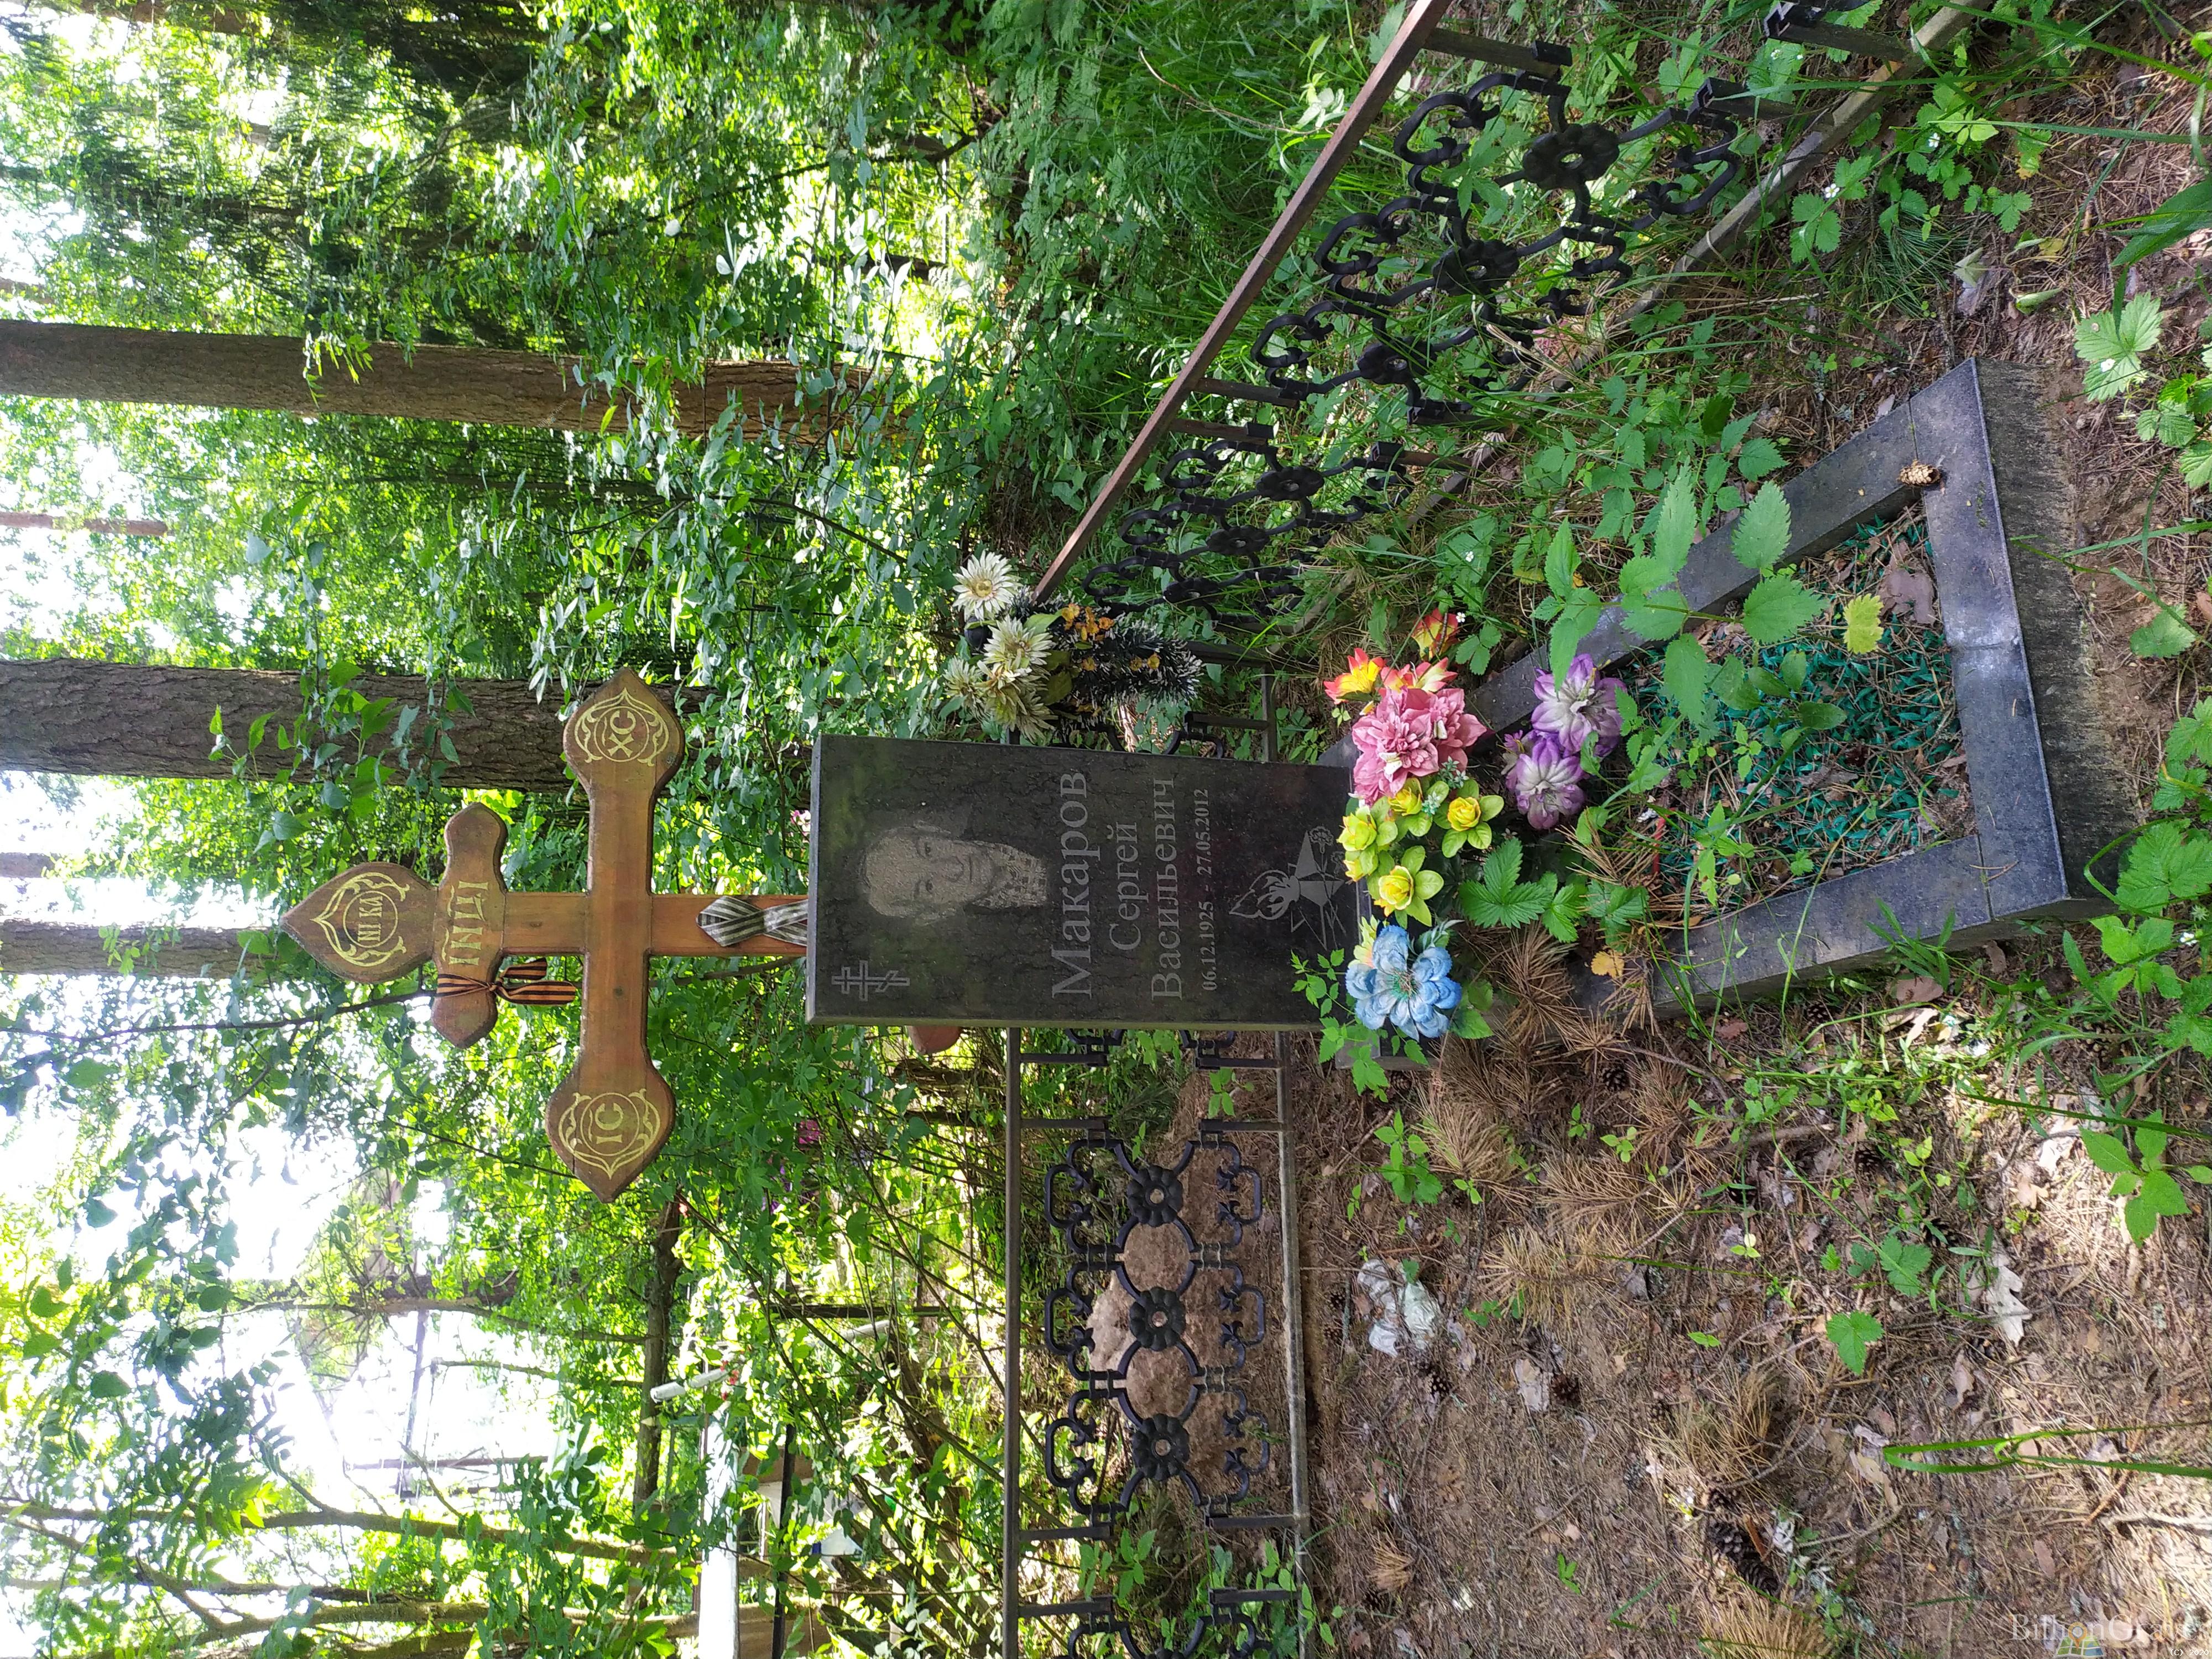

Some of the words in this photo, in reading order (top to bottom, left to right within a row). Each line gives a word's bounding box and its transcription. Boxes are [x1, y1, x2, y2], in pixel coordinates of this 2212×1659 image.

[1051, 773, 1100, 1000] Макаров
[1107, 821, 1149, 951] Сергей
[1151, 778, 1182, 1000] Васильевич
[1193, 788, 1212, 875] 27.05.2012
[1198, 901, 1217, 991] 06.12.1925
